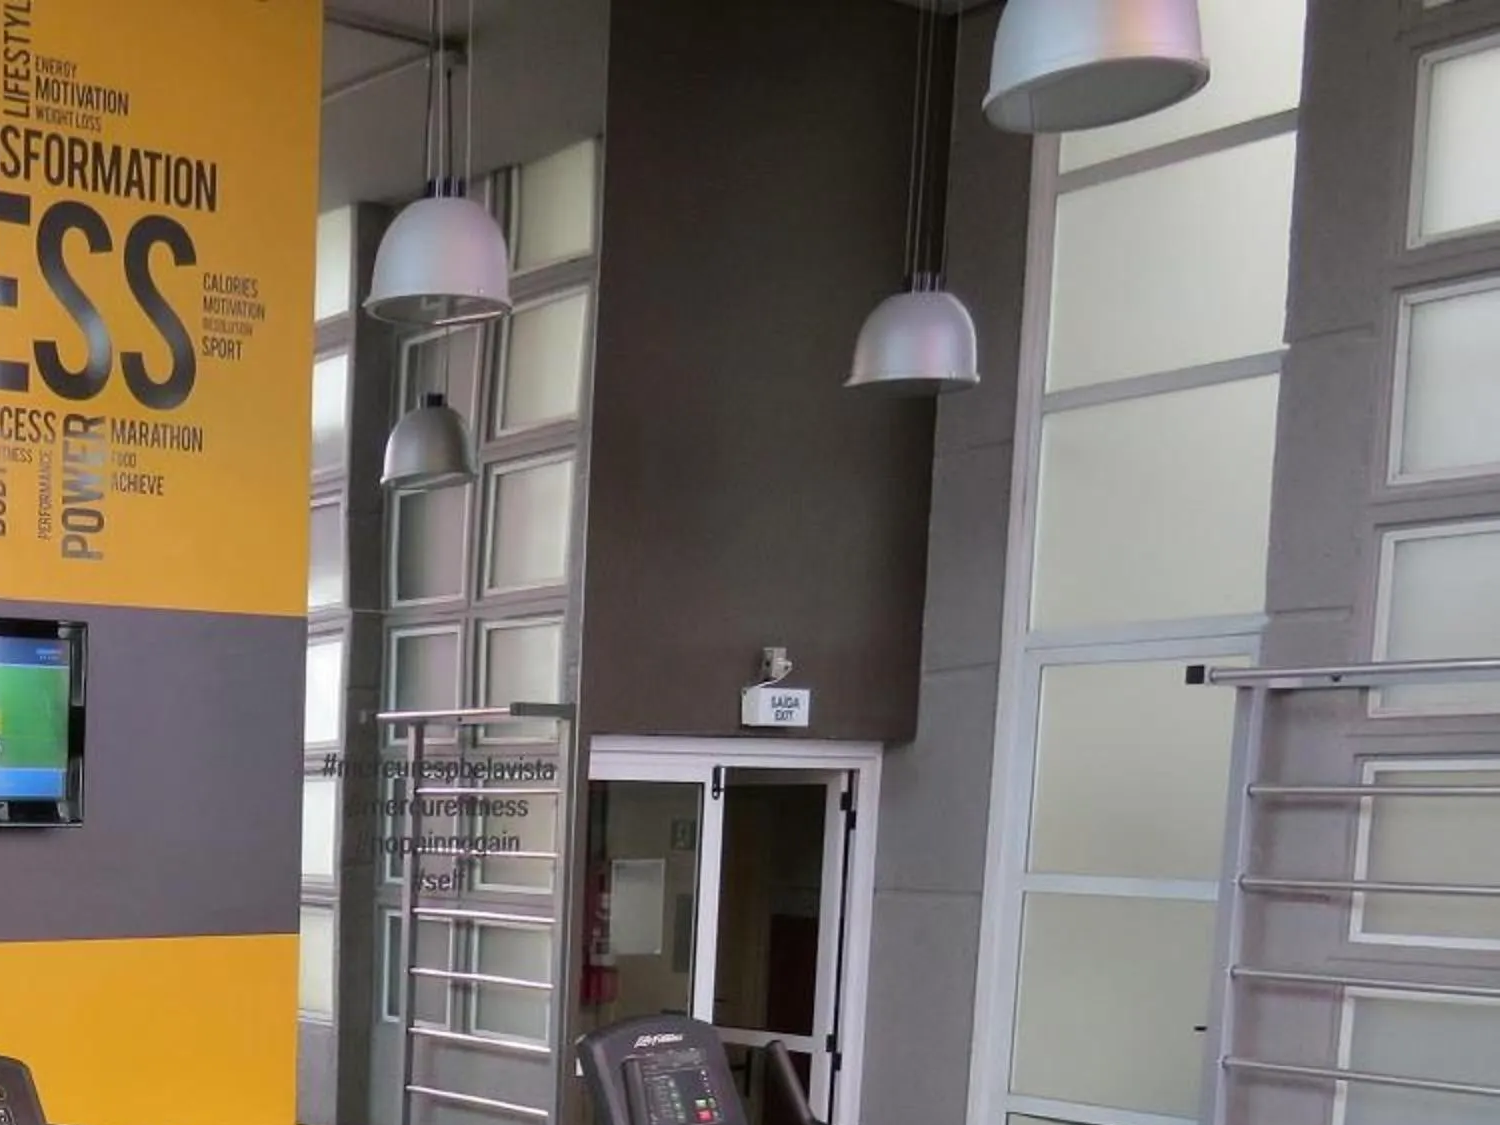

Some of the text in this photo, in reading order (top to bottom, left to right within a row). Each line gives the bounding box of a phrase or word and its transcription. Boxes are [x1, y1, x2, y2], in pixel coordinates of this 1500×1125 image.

[35, 55, 78, 79] ENERGY
[35, 76, 130, 118] MOTIVATION
[35, 105, 102, 133] WEIGHT LOSS
[203, 271, 259, 299] CALORIES
[202, 335, 243, 361] SPORT
[110, 416, 204, 453] MARATHON
[61, 412, 106, 562] POWER
[111, 471, 164, 497] ACHIEVE
